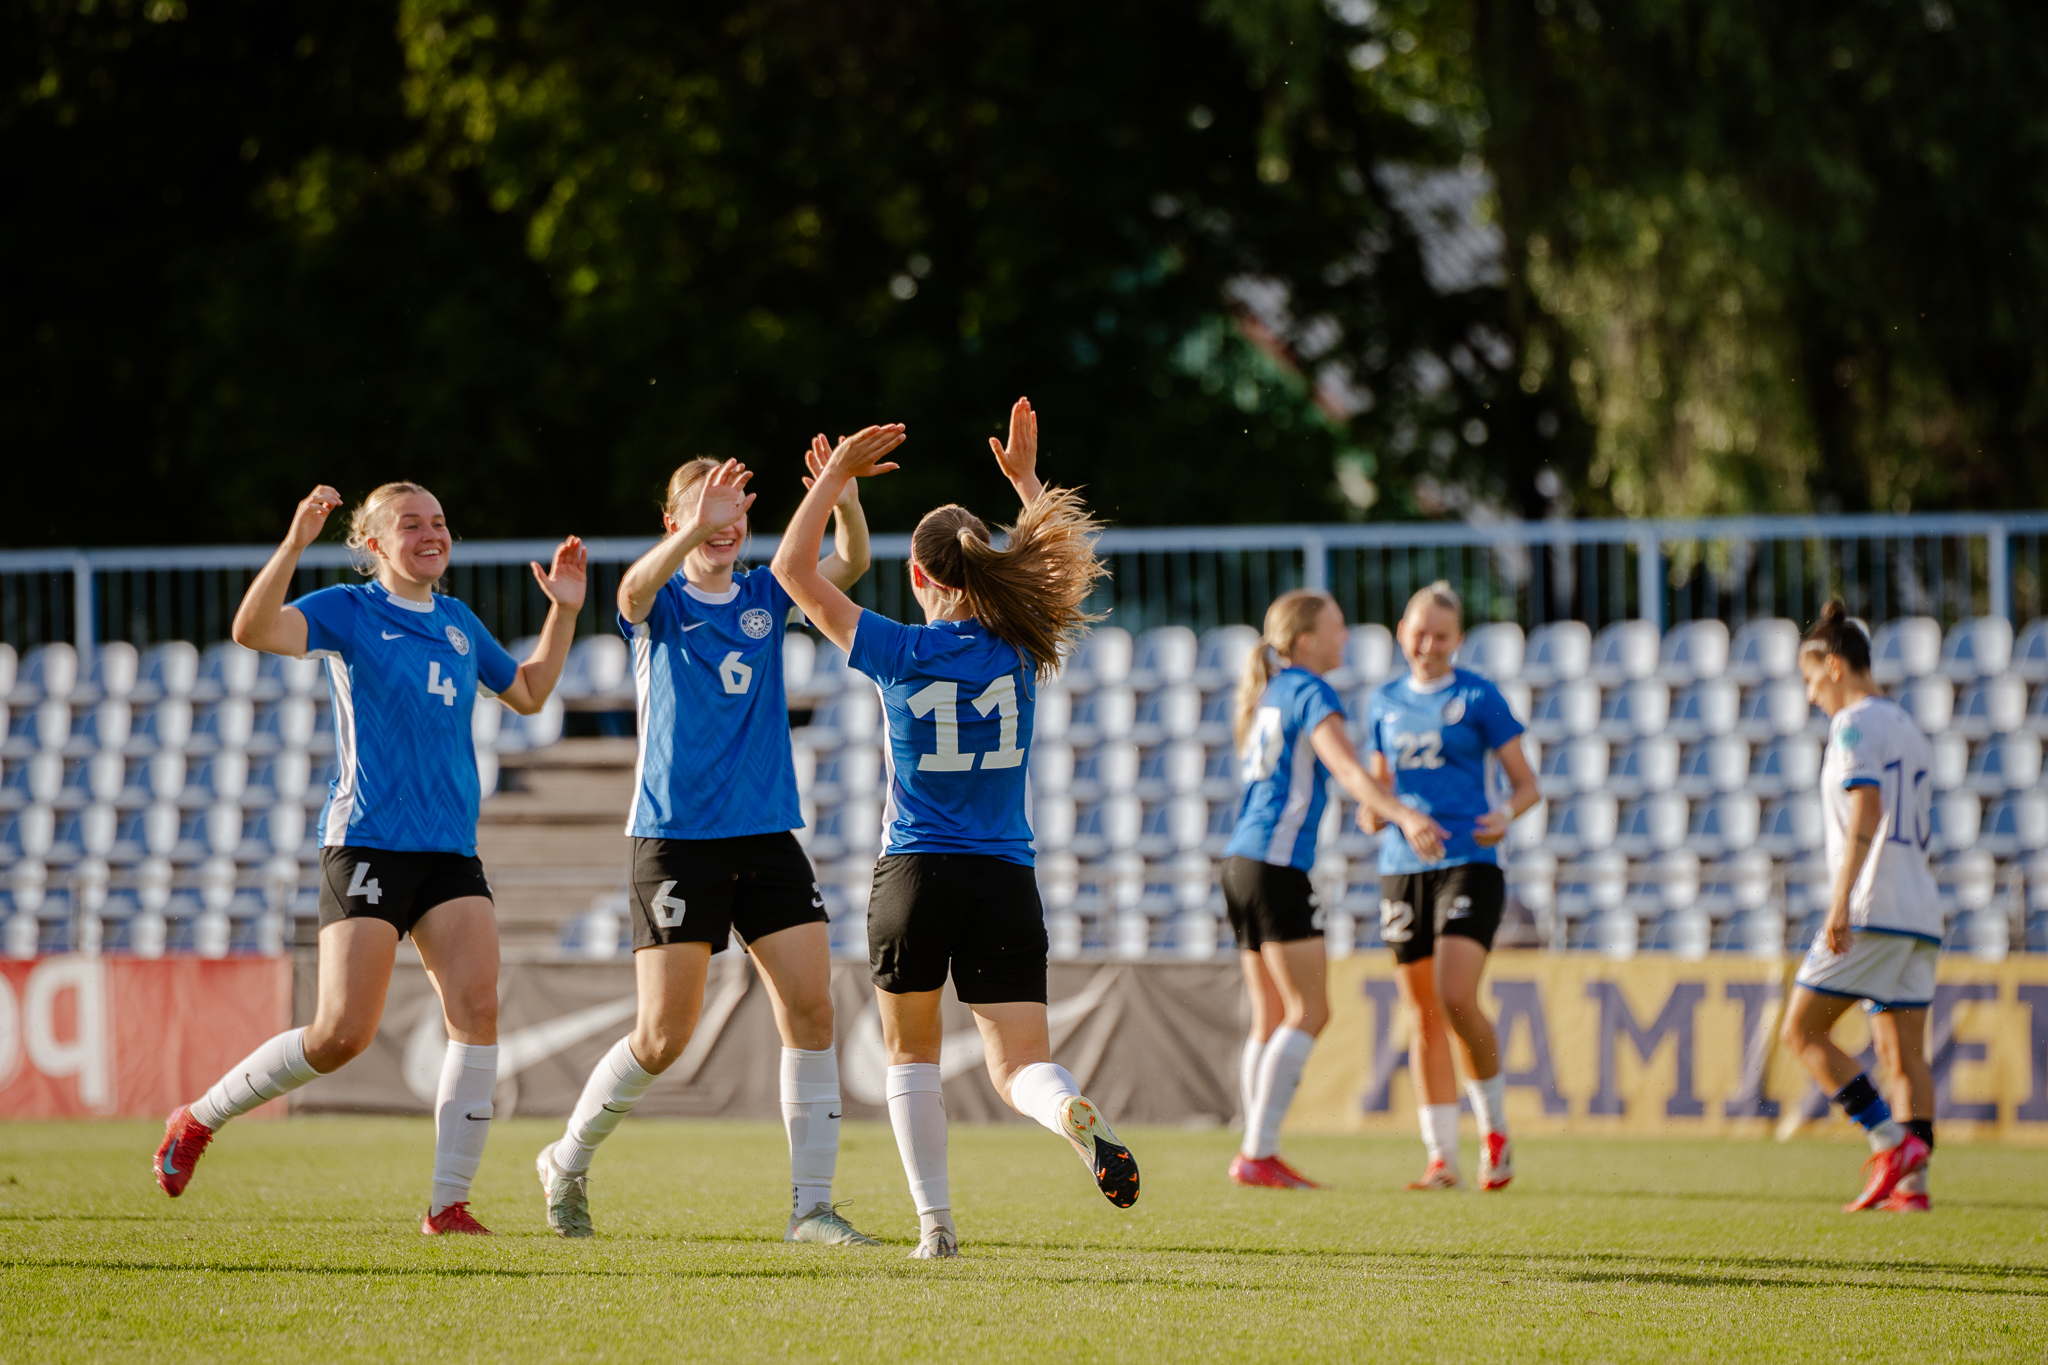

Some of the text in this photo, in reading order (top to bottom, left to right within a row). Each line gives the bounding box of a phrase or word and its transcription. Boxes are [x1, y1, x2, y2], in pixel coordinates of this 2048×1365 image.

[427, 661, 457, 706] 4
[719, 651, 752, 694] 6
[907, 674, 1025, 772] 11
[1394, 731, 1445, 770] 22
[346, 862, 382, 905] 4
[651, 880, 686, 928] 6
